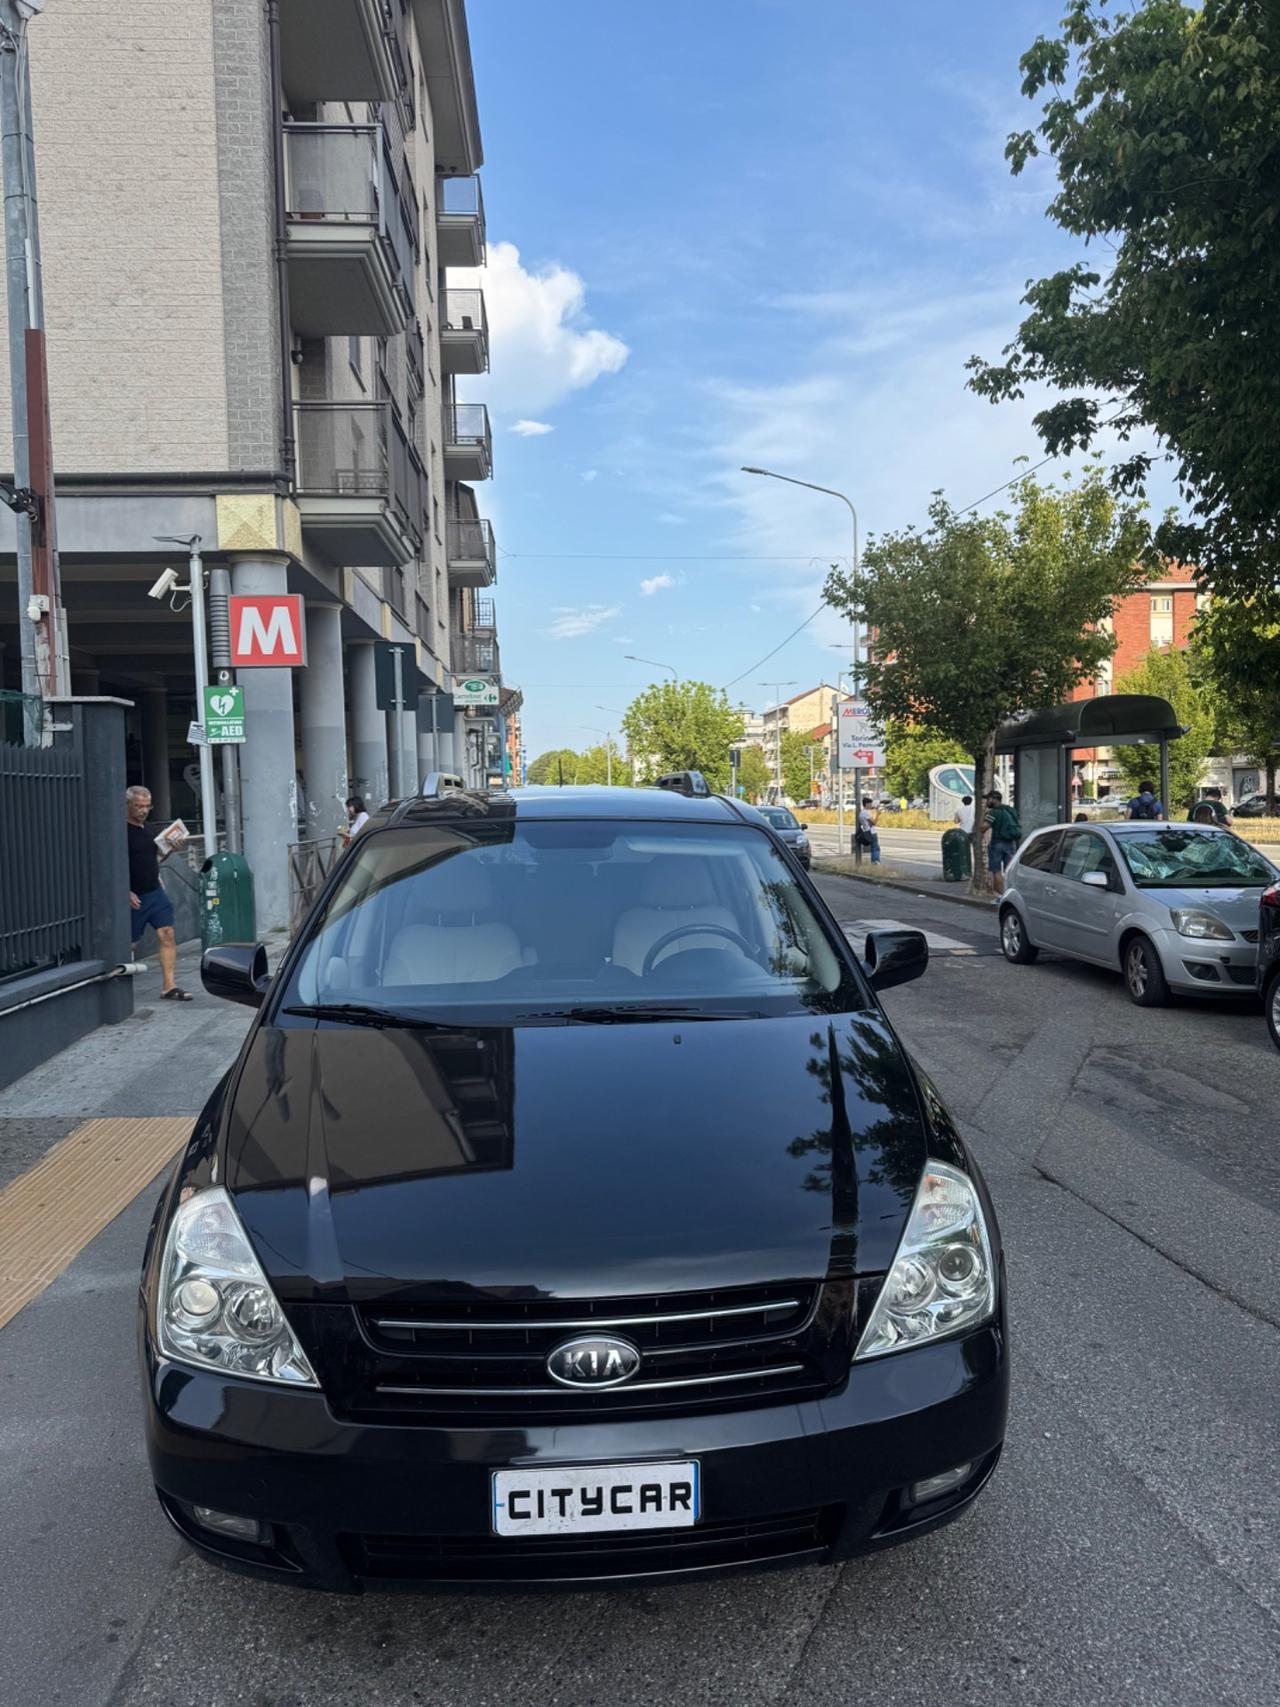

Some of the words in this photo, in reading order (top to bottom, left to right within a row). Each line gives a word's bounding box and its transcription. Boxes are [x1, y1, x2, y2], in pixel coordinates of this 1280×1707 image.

[237, 606, 298, 655] M
[221, 725, 243, 737] AED
[563, 1350, 626, 1377] KIA
[508, 1481, 692, 1520] CITYCAR
